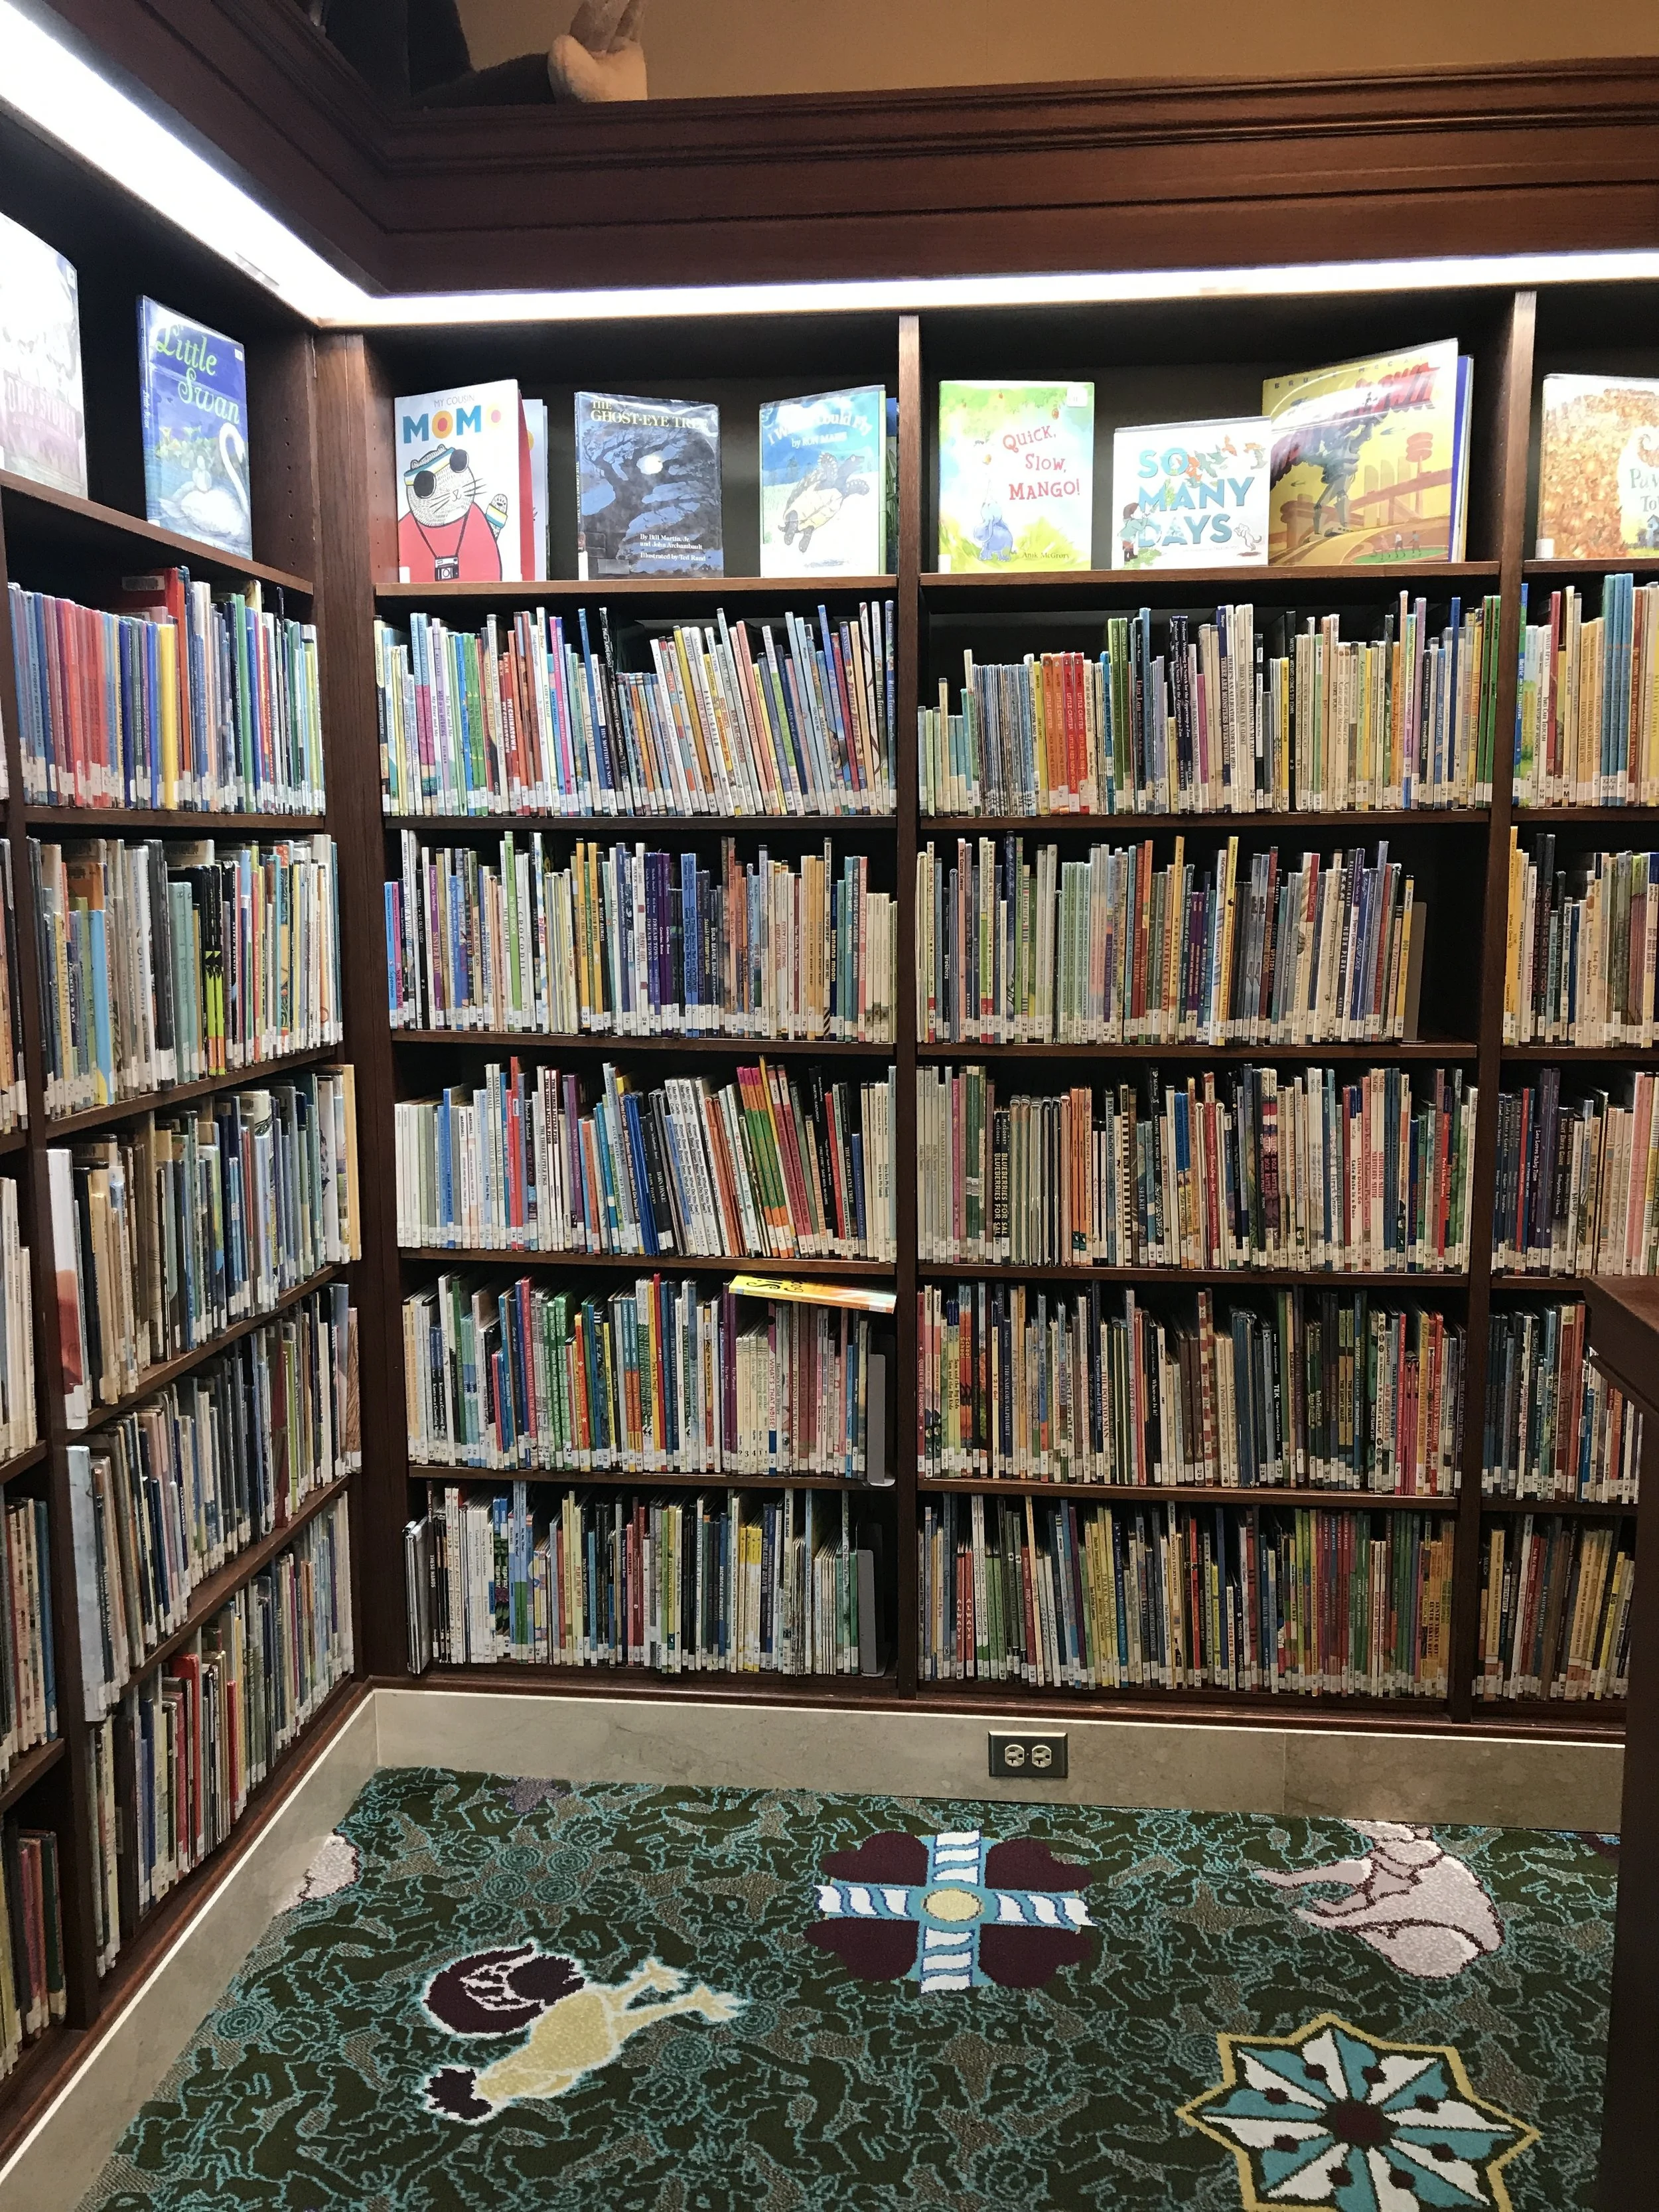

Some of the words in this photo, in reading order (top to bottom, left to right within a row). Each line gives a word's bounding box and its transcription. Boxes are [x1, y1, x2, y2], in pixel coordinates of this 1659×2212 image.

[156, 324, 217, 376] Little
[178, 368, 240, 424] Swan
[434, 399, 445, 408] MY
[446, 394, 475, 406] COUSIN
[591, 400, 612, 409] THE
[403, 404, 504, 444] MOMO
[590, 409, 669, 427] GHOST-EYE
[791, 438, 800, 449] by
[1137, 447, 1189, 479] SO
[1139, 477, 1255, 512] MANY
[1138, 513, 1232, 548] DAYS
[586, 725, 595, 754] HOME
[602, 740, 611, 769] MOTHER'S
